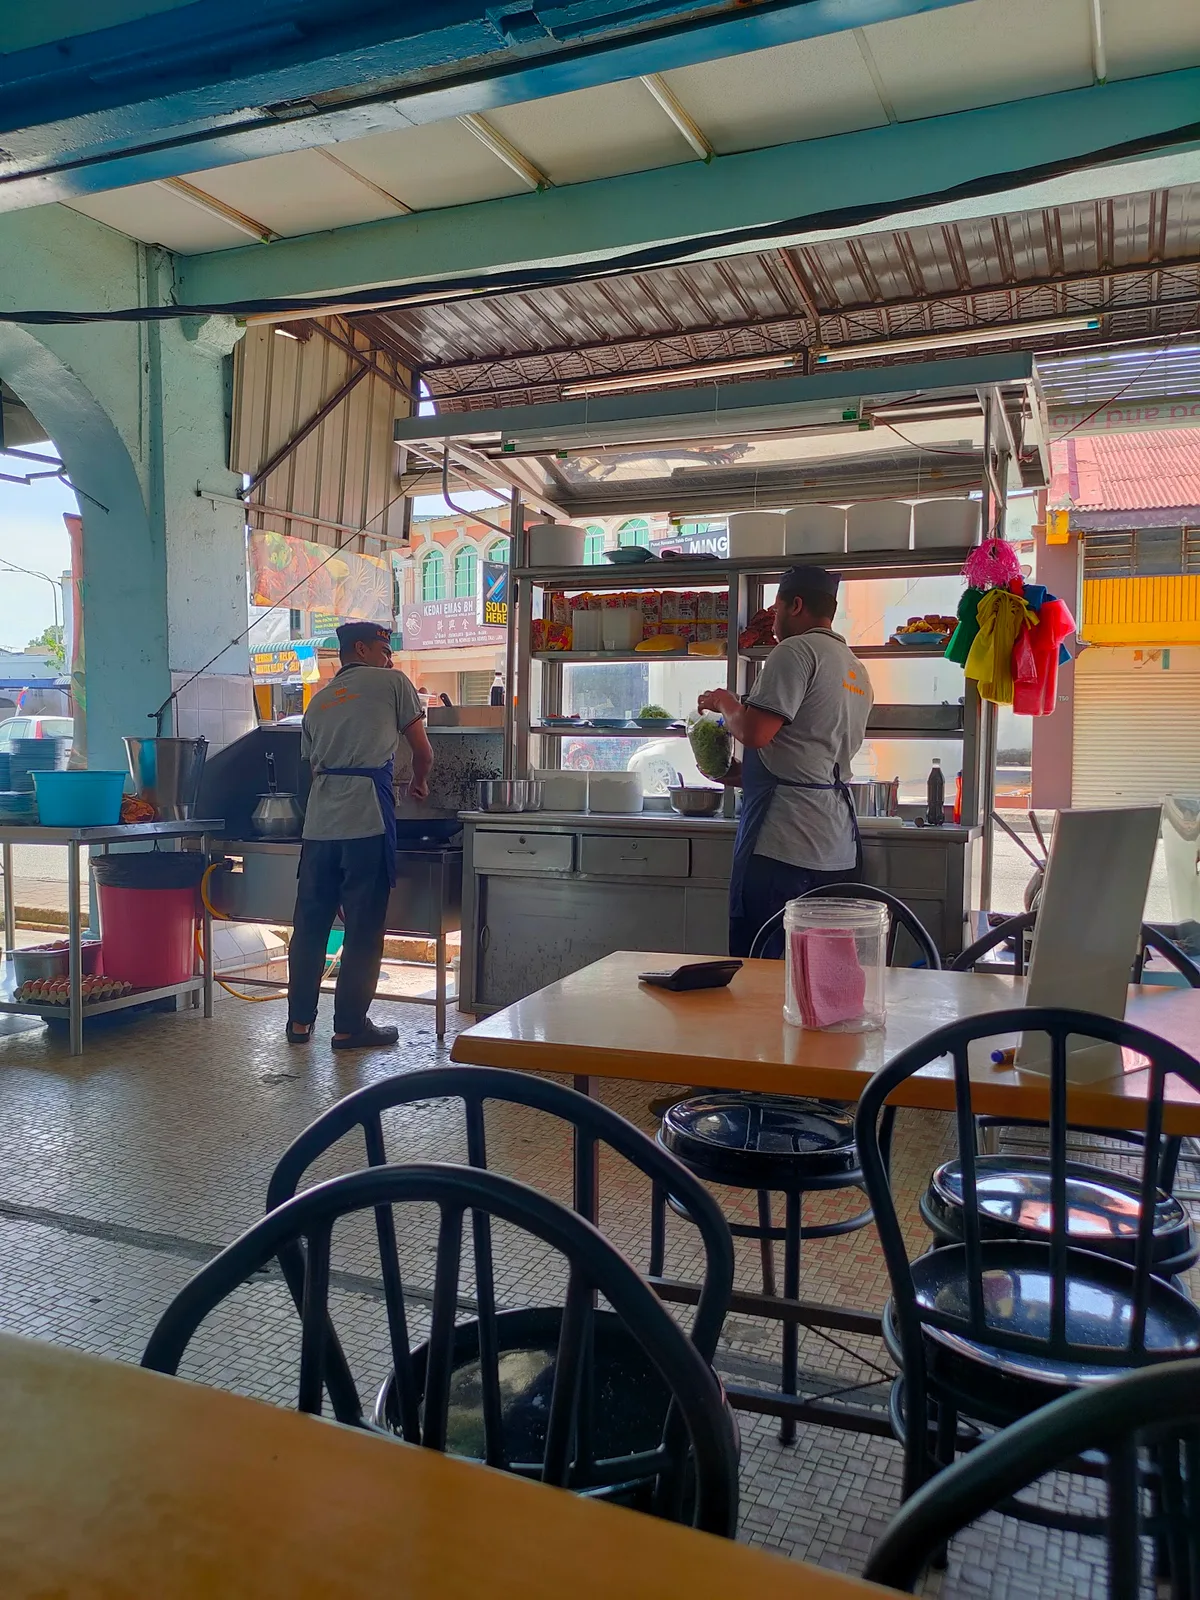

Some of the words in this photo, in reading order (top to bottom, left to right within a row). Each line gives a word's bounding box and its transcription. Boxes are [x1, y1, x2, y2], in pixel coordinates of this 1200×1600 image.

[1106, 407, 1160, 429] and
[689, 536, 728, 554] MING
[423, 603, 442, 617] KEDAI
[443, 601, 462, 615] EMAS
[485, 601, 508, 614] SOLD
[485, 612, 507, 624] HERE
